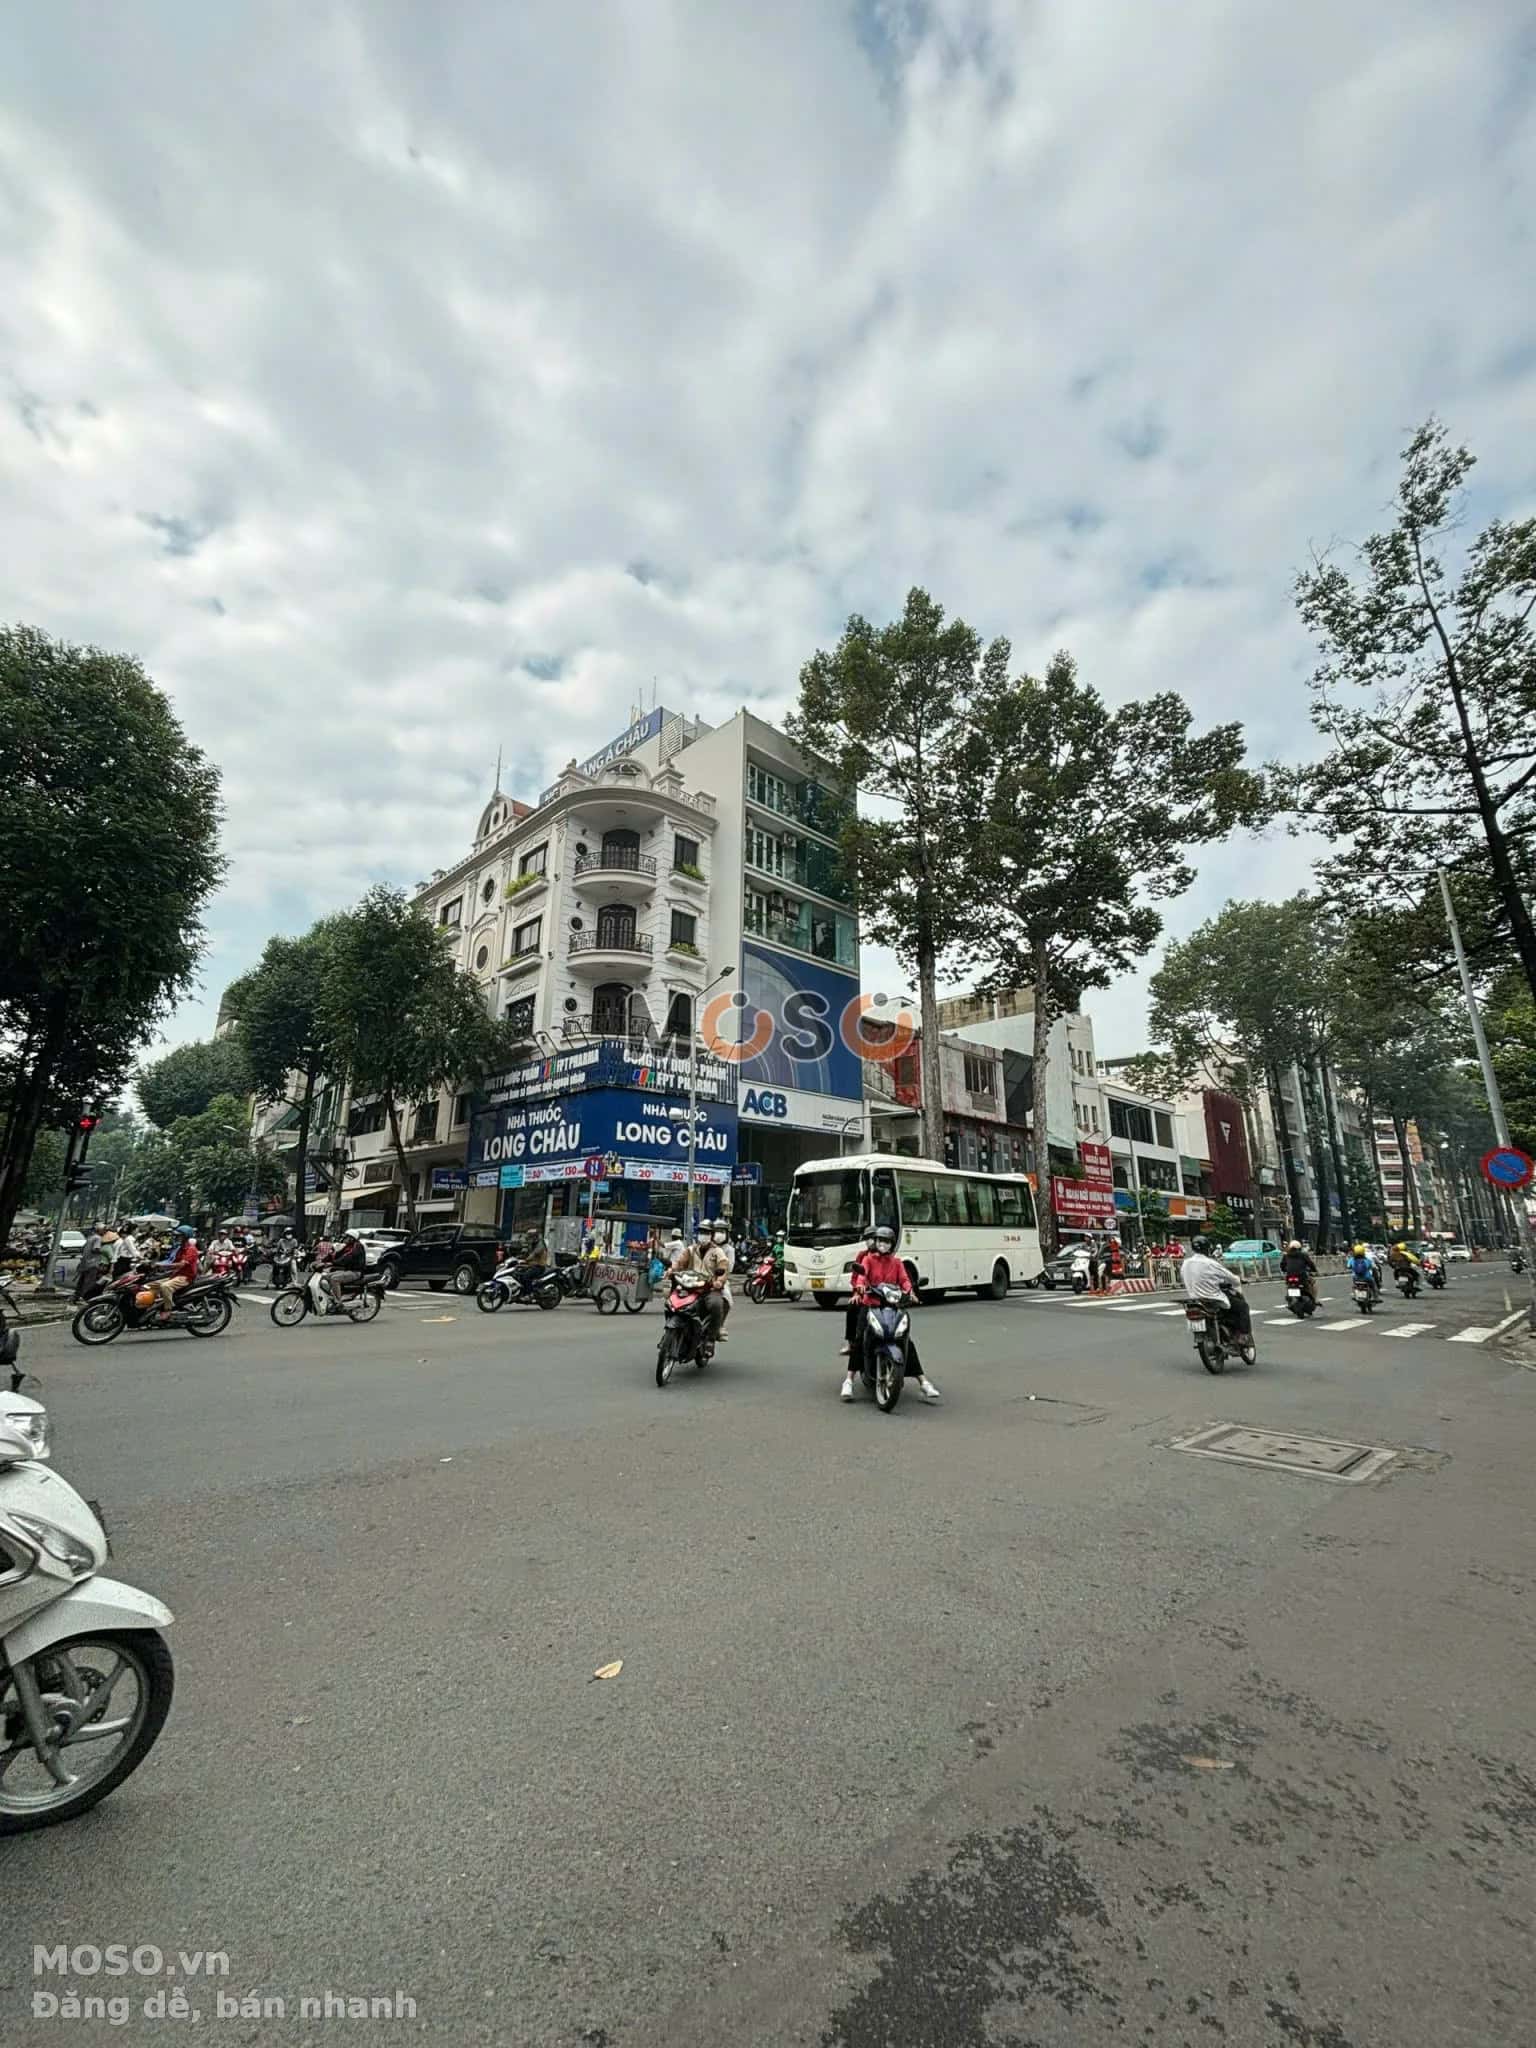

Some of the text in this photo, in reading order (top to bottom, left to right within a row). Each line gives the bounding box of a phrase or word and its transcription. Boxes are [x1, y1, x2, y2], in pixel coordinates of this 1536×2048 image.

[507, 1101, 562, 1130] NHÀ THUỐC
[643, 1102, 668, 1118] NHÀ
[742, 1088, 788, 1118] ACB
[483, 1119, 581, 1162] LONG CHÂU
[616, 1121, 728, 1151] LONG CHÂU
